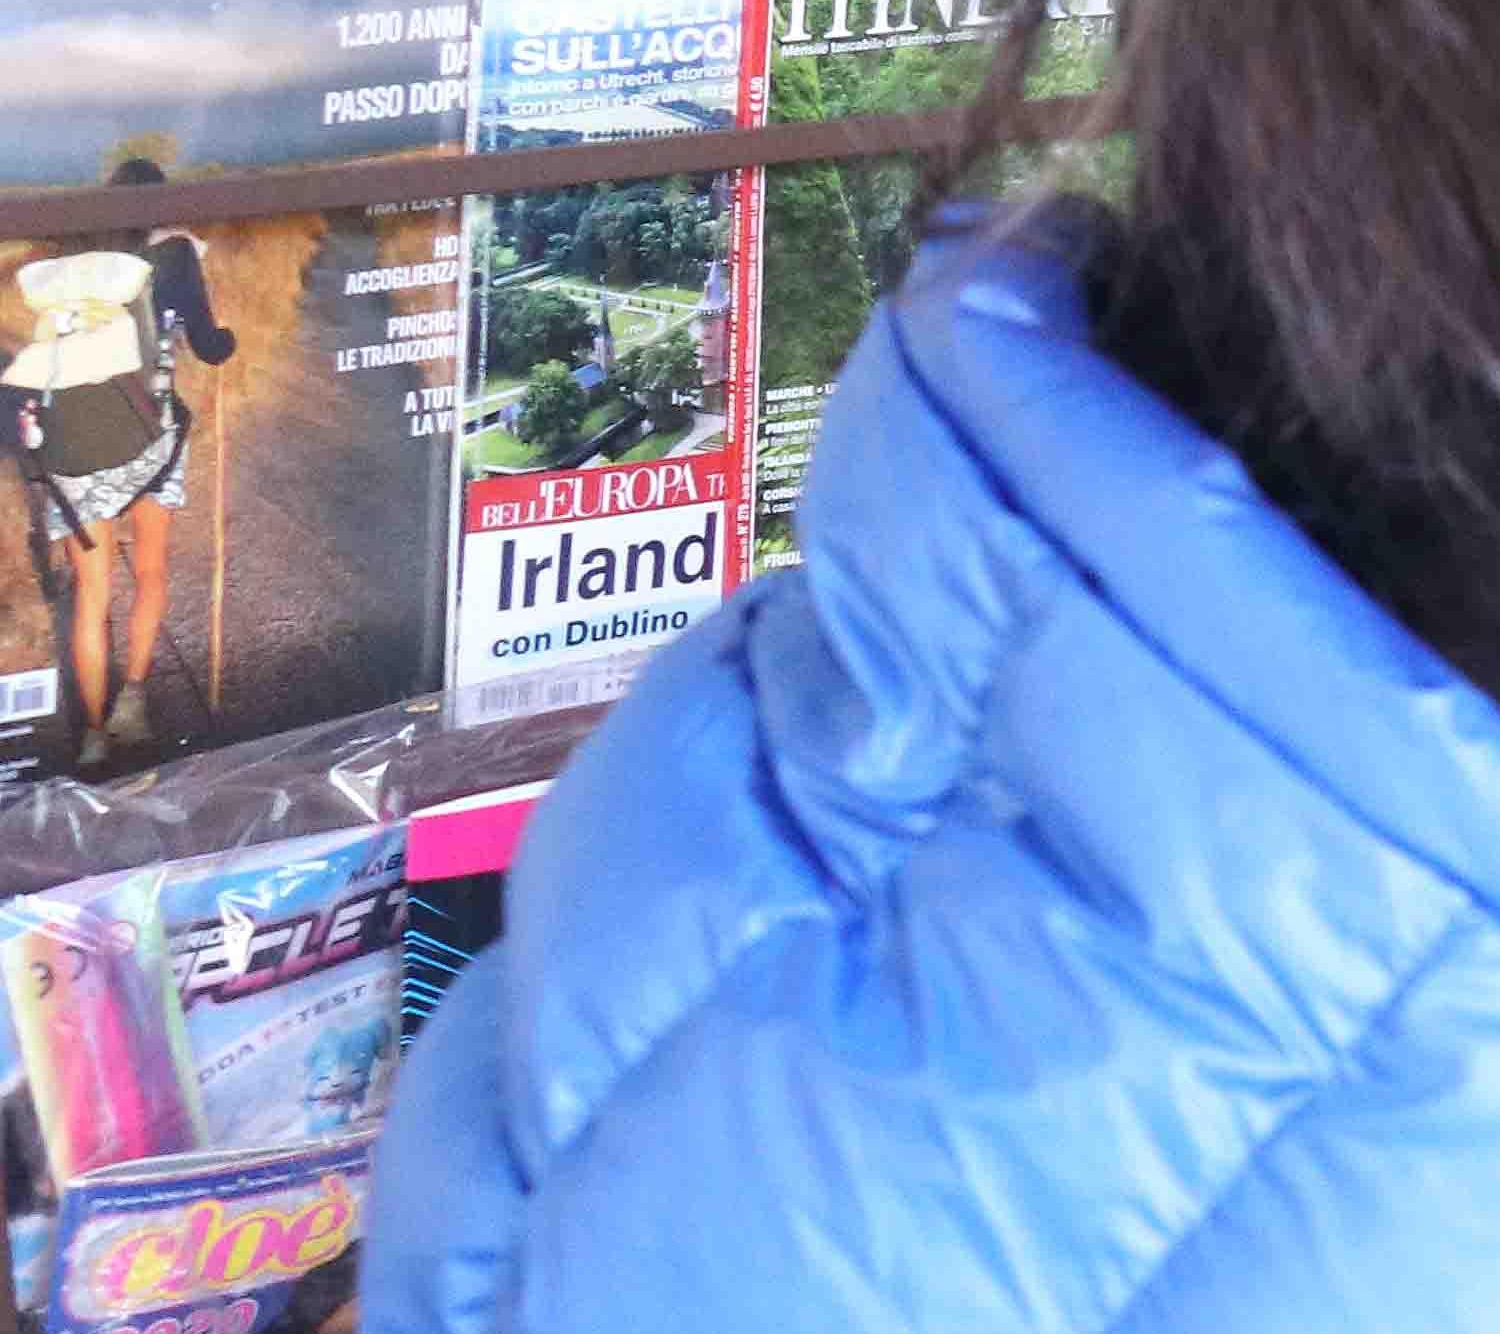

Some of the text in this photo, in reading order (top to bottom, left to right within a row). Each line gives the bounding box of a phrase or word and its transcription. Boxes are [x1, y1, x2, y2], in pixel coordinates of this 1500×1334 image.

[324, 84, 405, 126] PASSO
[491, 607, 689, 659] con Dublino
